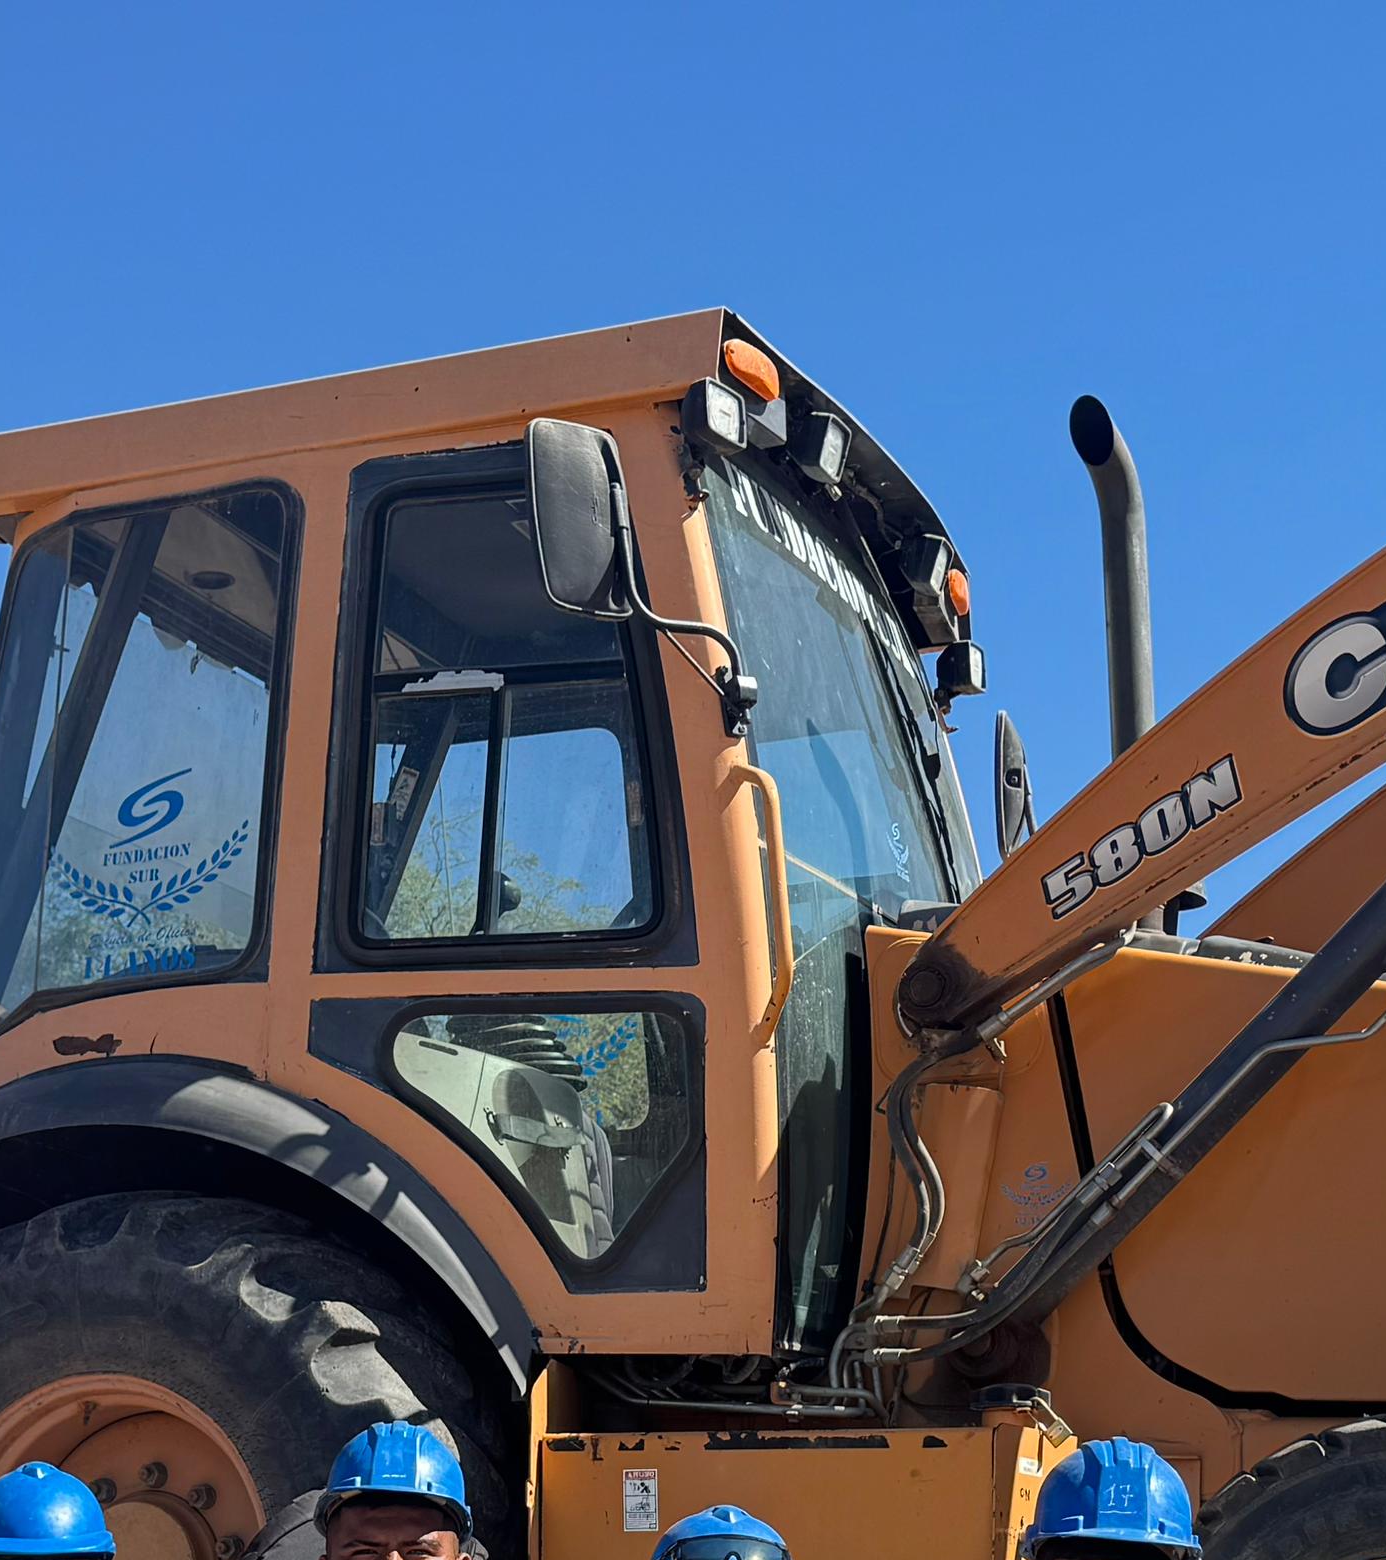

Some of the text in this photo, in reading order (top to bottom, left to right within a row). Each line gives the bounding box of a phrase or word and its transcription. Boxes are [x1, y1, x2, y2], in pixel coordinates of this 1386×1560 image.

[1042, 754, 1242, 920] 580N
[102, 842, 191, 867] FUNDACION
[128, 868, 160, 884] SUR
[118, 943, 197, 977] AÑOS
